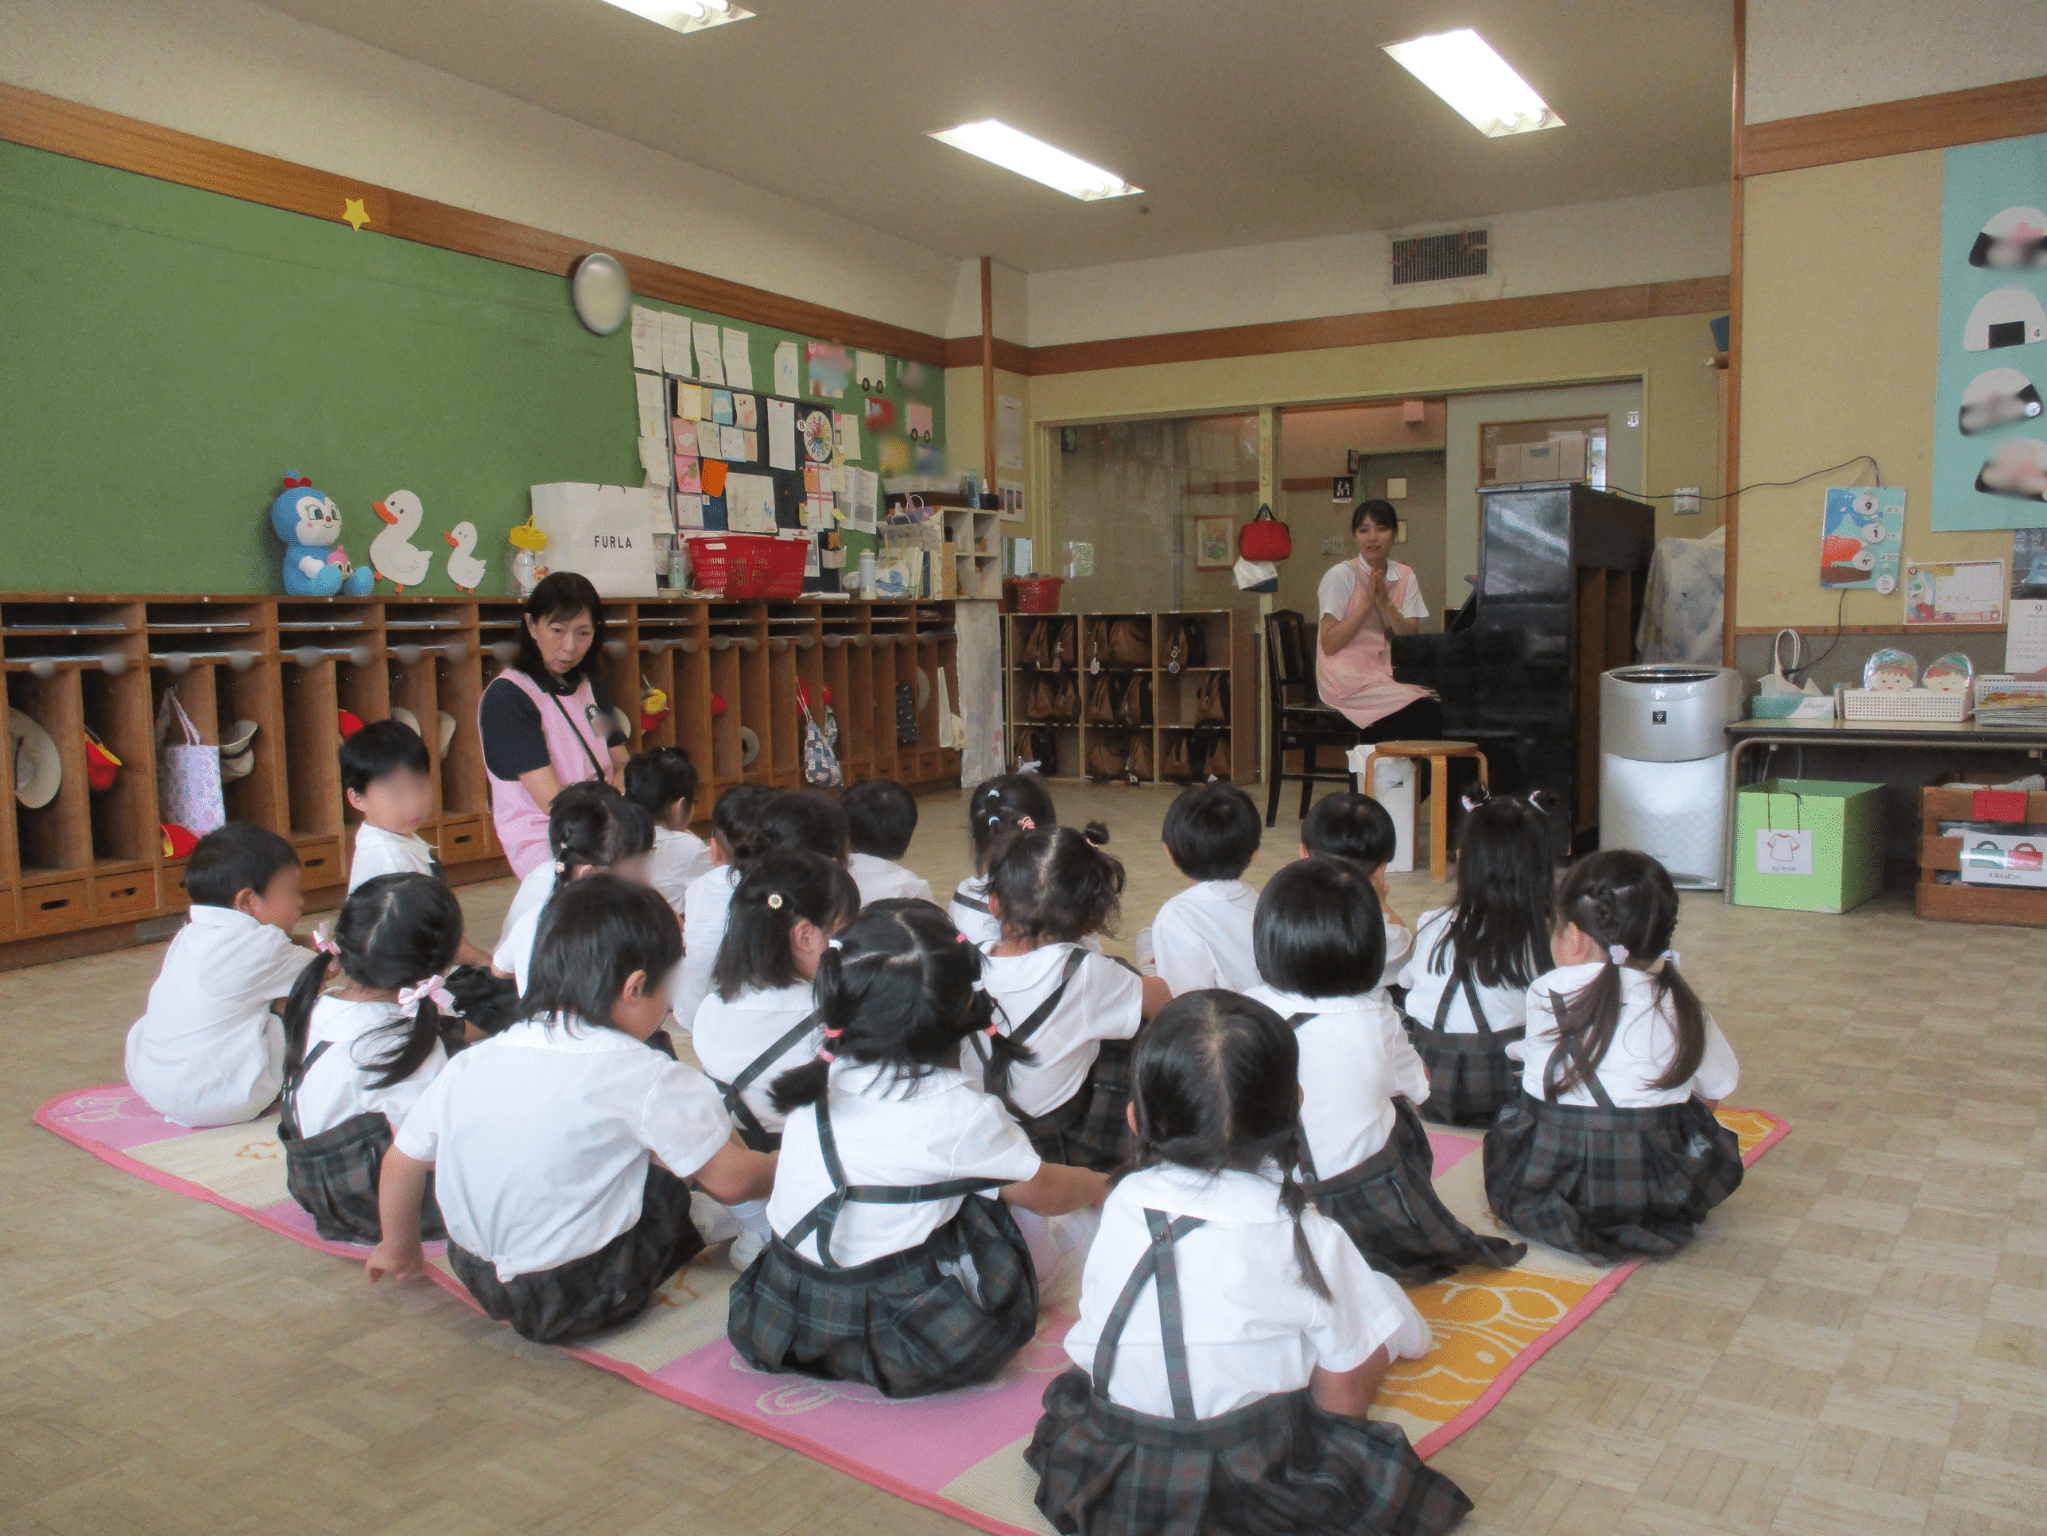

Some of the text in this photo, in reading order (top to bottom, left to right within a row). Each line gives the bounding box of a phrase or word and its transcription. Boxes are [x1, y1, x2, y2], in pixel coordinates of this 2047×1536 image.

[2033, 328, 2041, 338] 4
[799, 421, 805, 429] B
[1865, 501, 1873, 511] 9
[1873, 529, 1879, 539] 1
[594, 535, 632, 549] FURLA
[2035, 604, 2043, 614] 9
